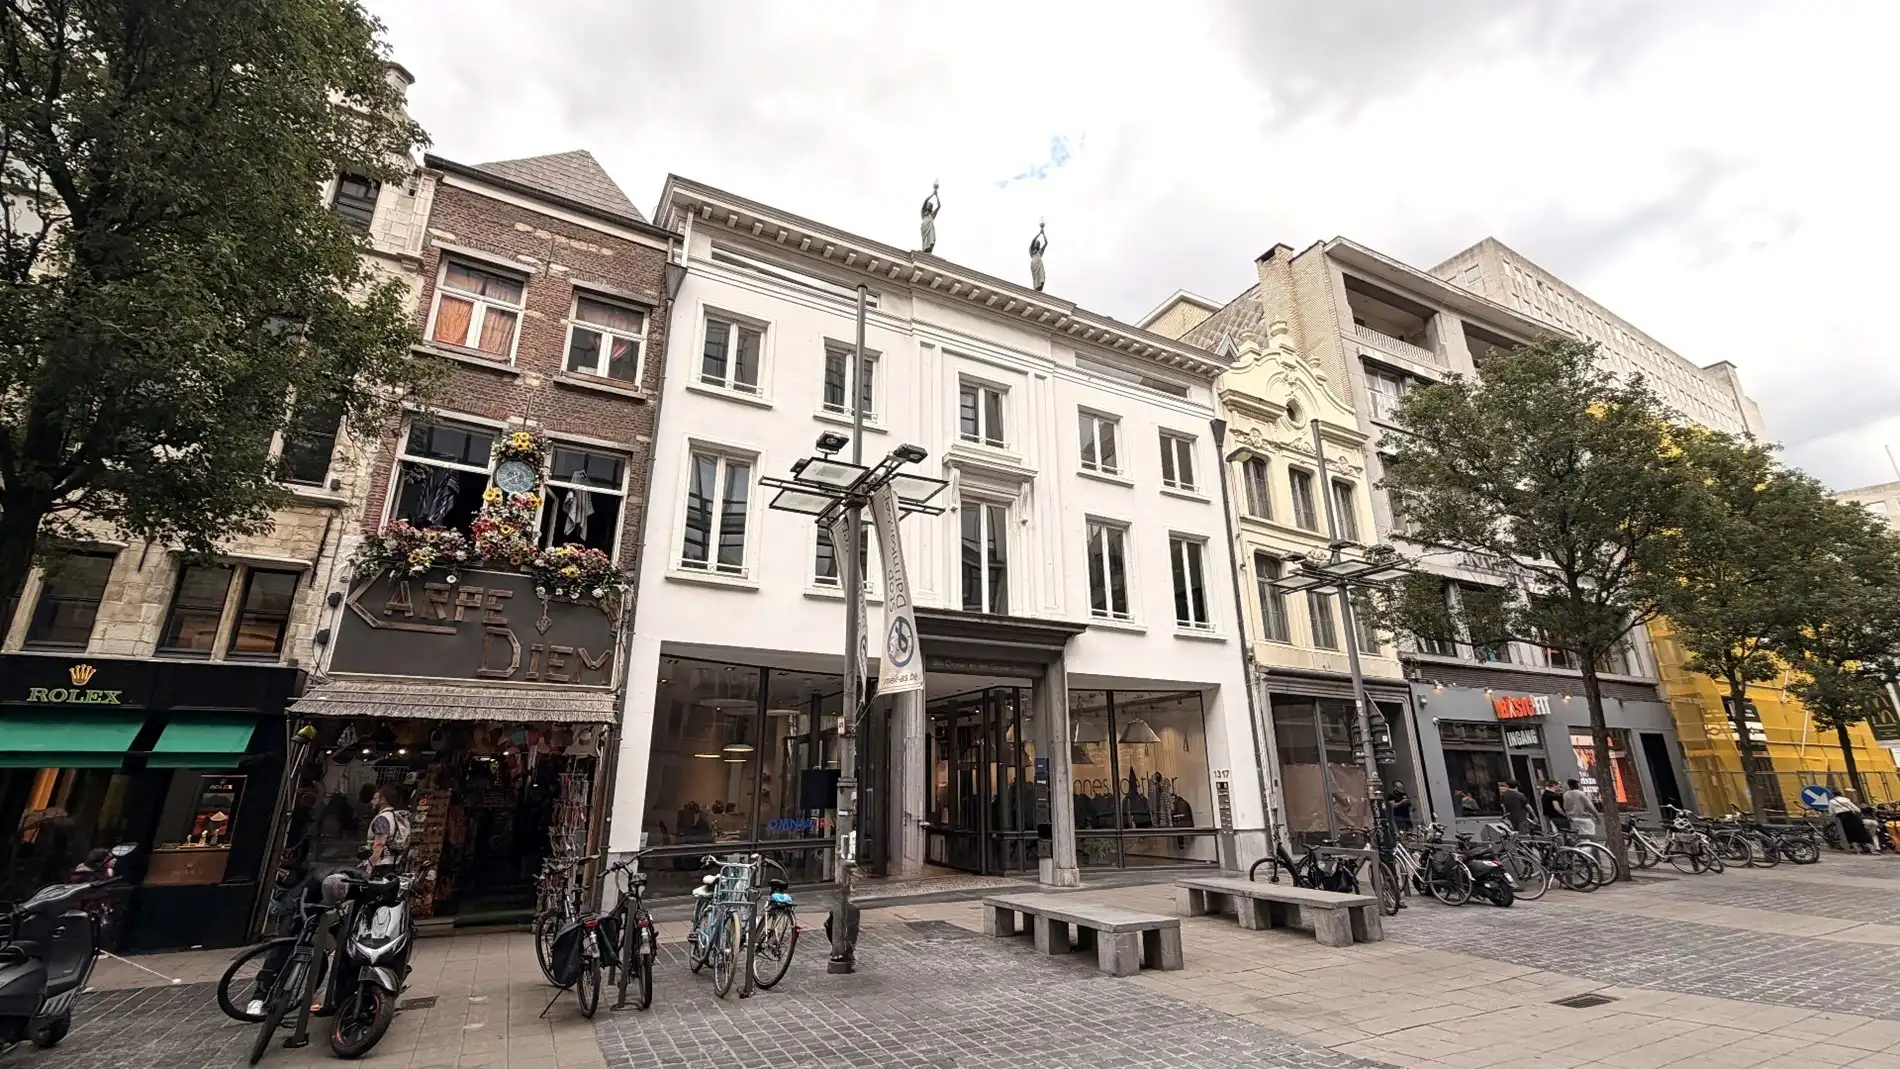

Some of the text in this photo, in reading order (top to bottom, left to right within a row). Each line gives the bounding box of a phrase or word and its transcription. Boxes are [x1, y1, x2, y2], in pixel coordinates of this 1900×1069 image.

[476, 626, 613, 685] DIEM
[26, 687, 122, 705] ROLEX
[1506, 729, 1538, 747] INGANG
